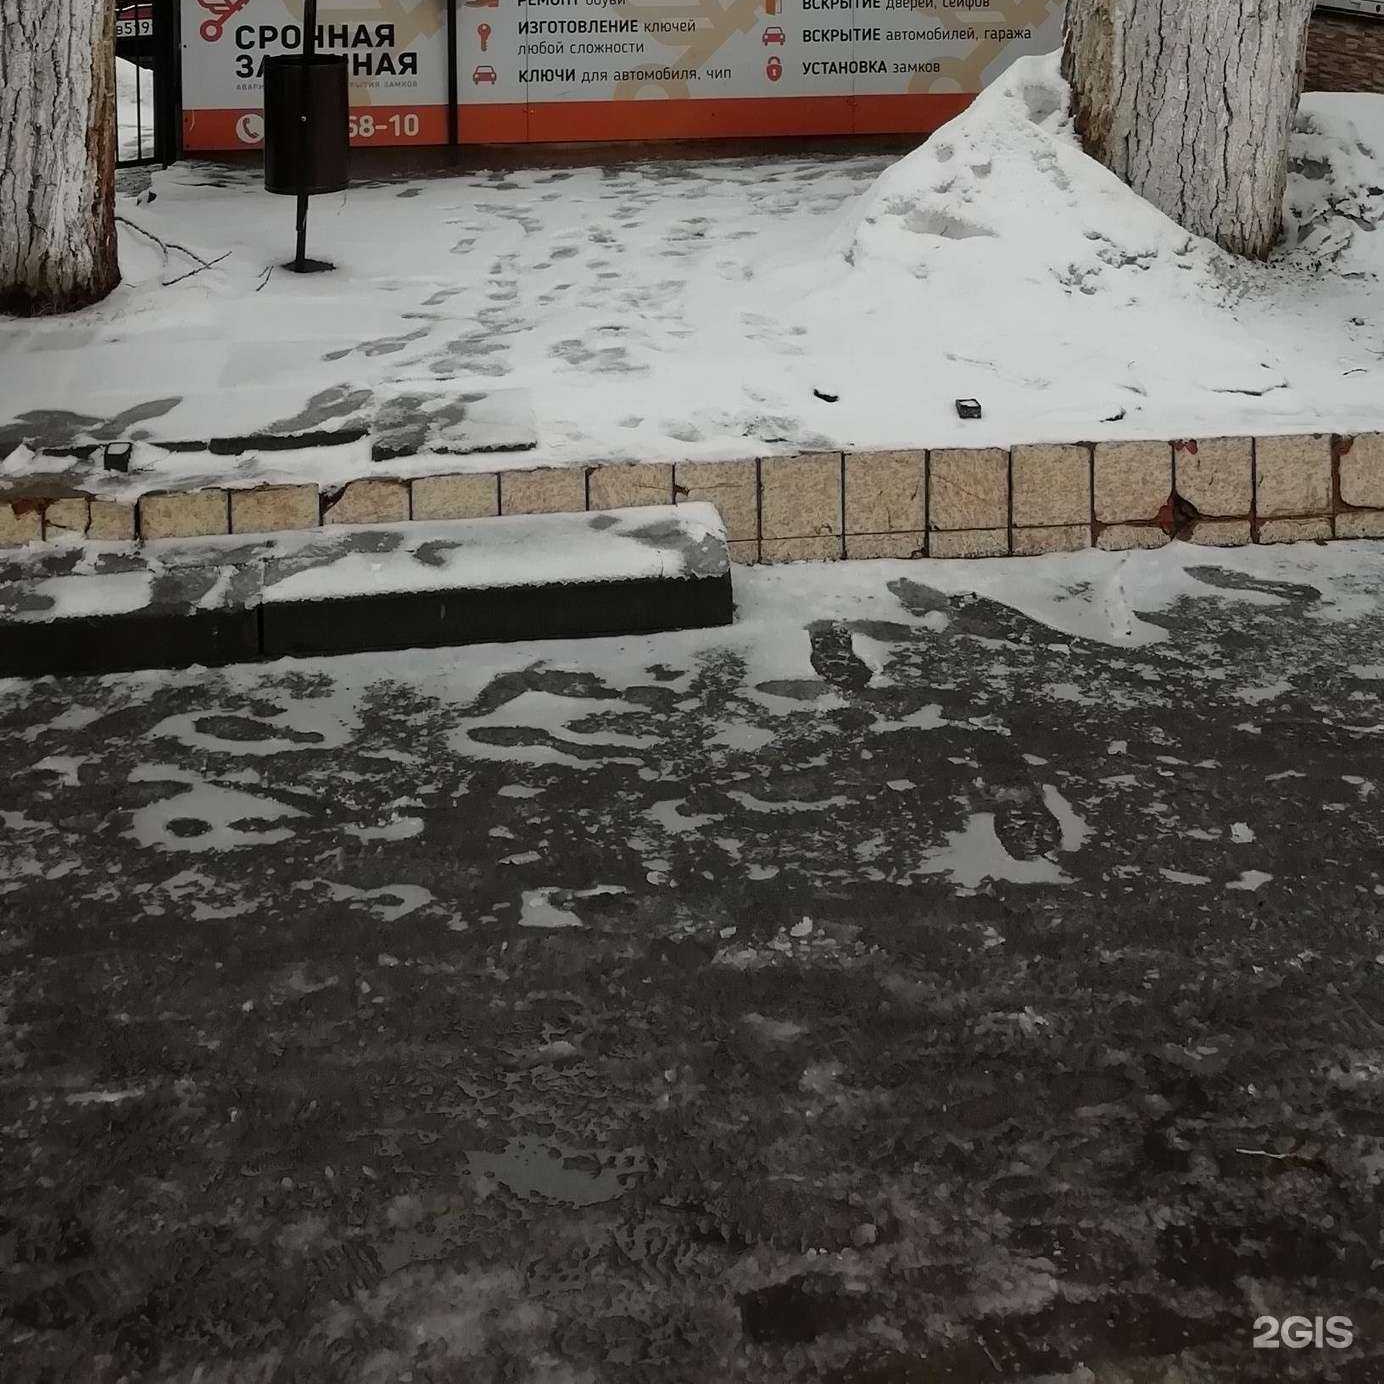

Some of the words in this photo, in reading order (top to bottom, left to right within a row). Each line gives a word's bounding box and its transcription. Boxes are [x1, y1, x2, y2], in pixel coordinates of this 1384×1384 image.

[517, 19, 638, 35] ИЗГОТОВЛЕНИЕ
[643, 19, 696, 33] ключей
[802, 28, 881, 42] ВСКРЫТИЕ
[885, 25, 979, 41] автомобилей,
[984, 27, 1031, 43] гаража
[517, 40, 564, 56] любой
[569, 42, 644, 55] сложности
[802, 60, 888, 75] УСТАНОВКА
[892, 61, 941, 74] замков
[518, 68, 576, 83] КЛЮЧИ
[581, 72, 608, 84] для
[706, 68, 732, 80] чип
